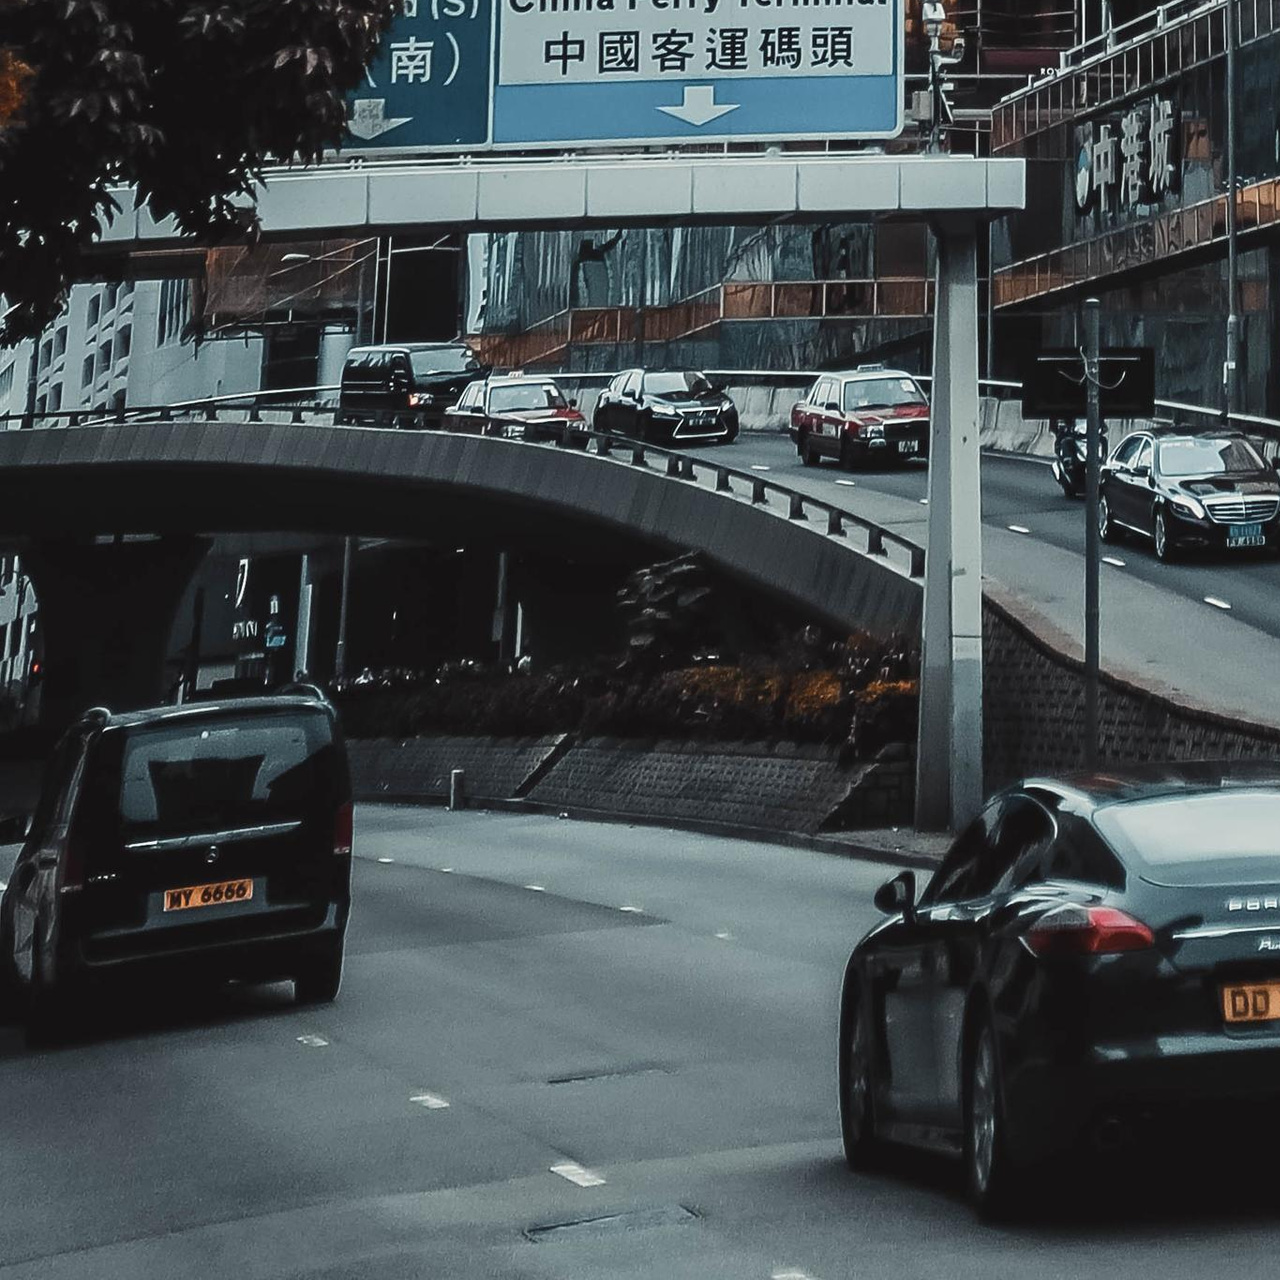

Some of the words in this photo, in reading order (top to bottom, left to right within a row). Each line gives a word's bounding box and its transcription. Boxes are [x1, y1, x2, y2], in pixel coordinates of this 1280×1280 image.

[543, 26, 854, 76] 中國客運碼頭
[1092, 93, 1174, 213] 中港城
[200, 881, 247, 903] 6666
[1230, 989, 1270, 1018] DD
